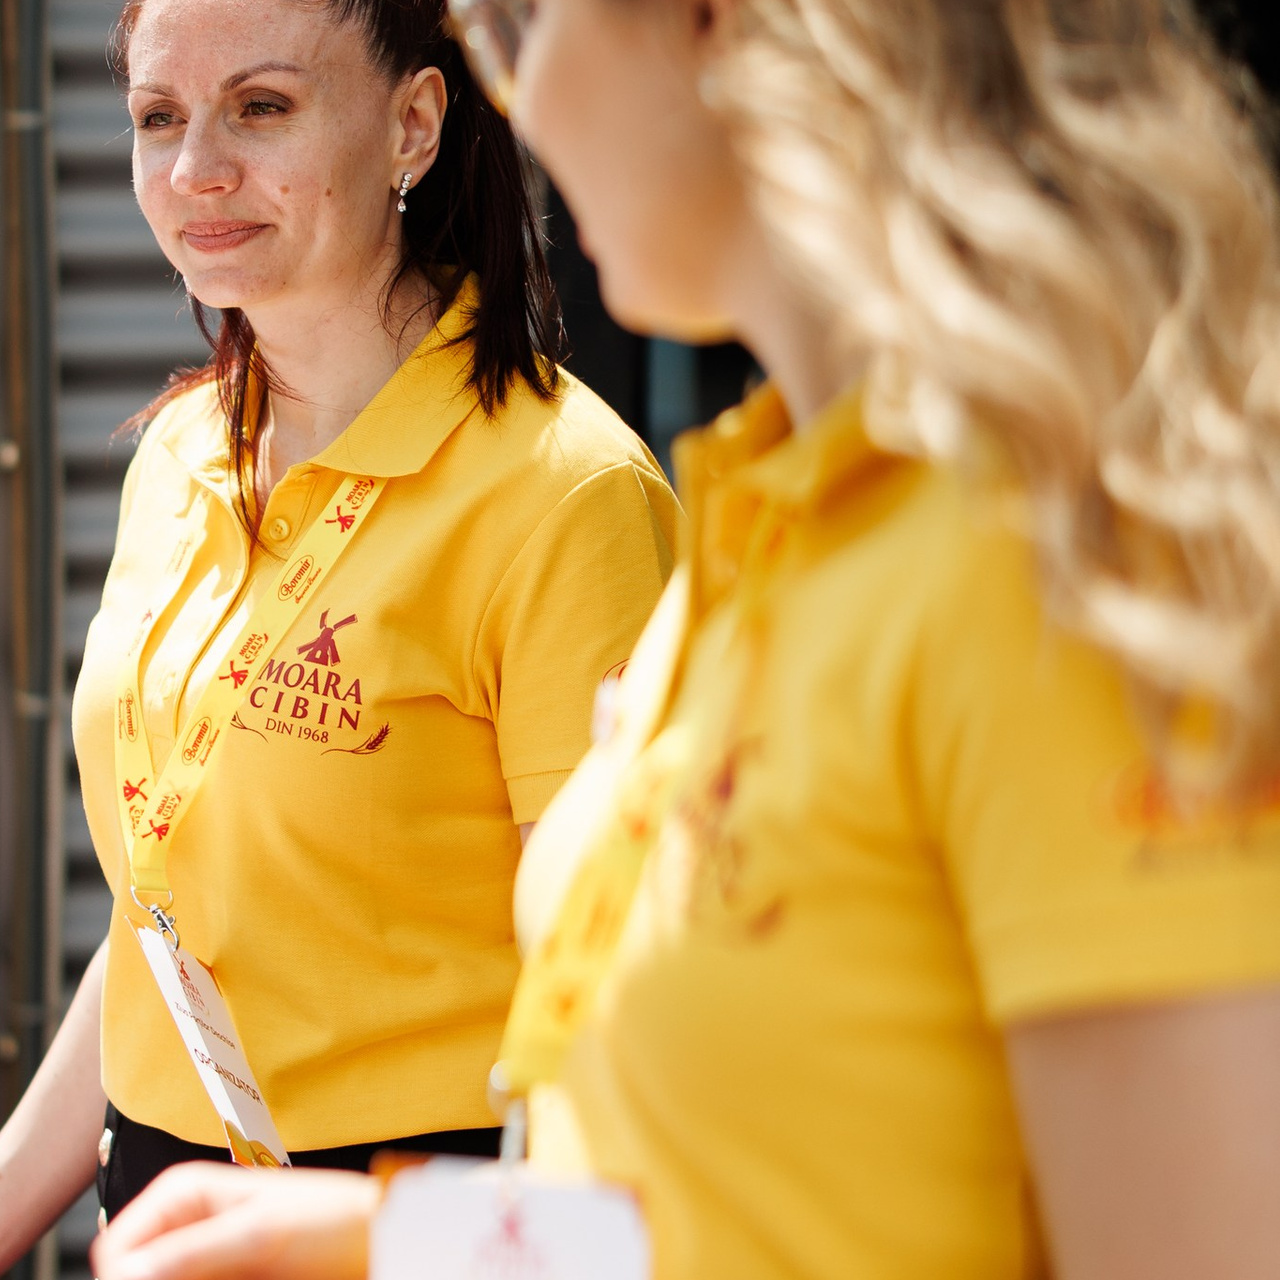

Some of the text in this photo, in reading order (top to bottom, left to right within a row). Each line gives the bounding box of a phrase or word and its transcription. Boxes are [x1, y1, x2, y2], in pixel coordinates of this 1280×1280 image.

[345, 479, 364, 503] MOARA
[351, 480, 370, 506] CIBIN
[280, 557, 311, 597] Boromir
[239, 633, 258, 657] MOARA
[244, 634, 264, 659] CIBIN
[257, 658, 363, 705] MOARA
[249, 686, 361, 731] CIBIN
[183, 721, 210, 761] Boromir
[265, 717, 329, 744] DIN 1968
